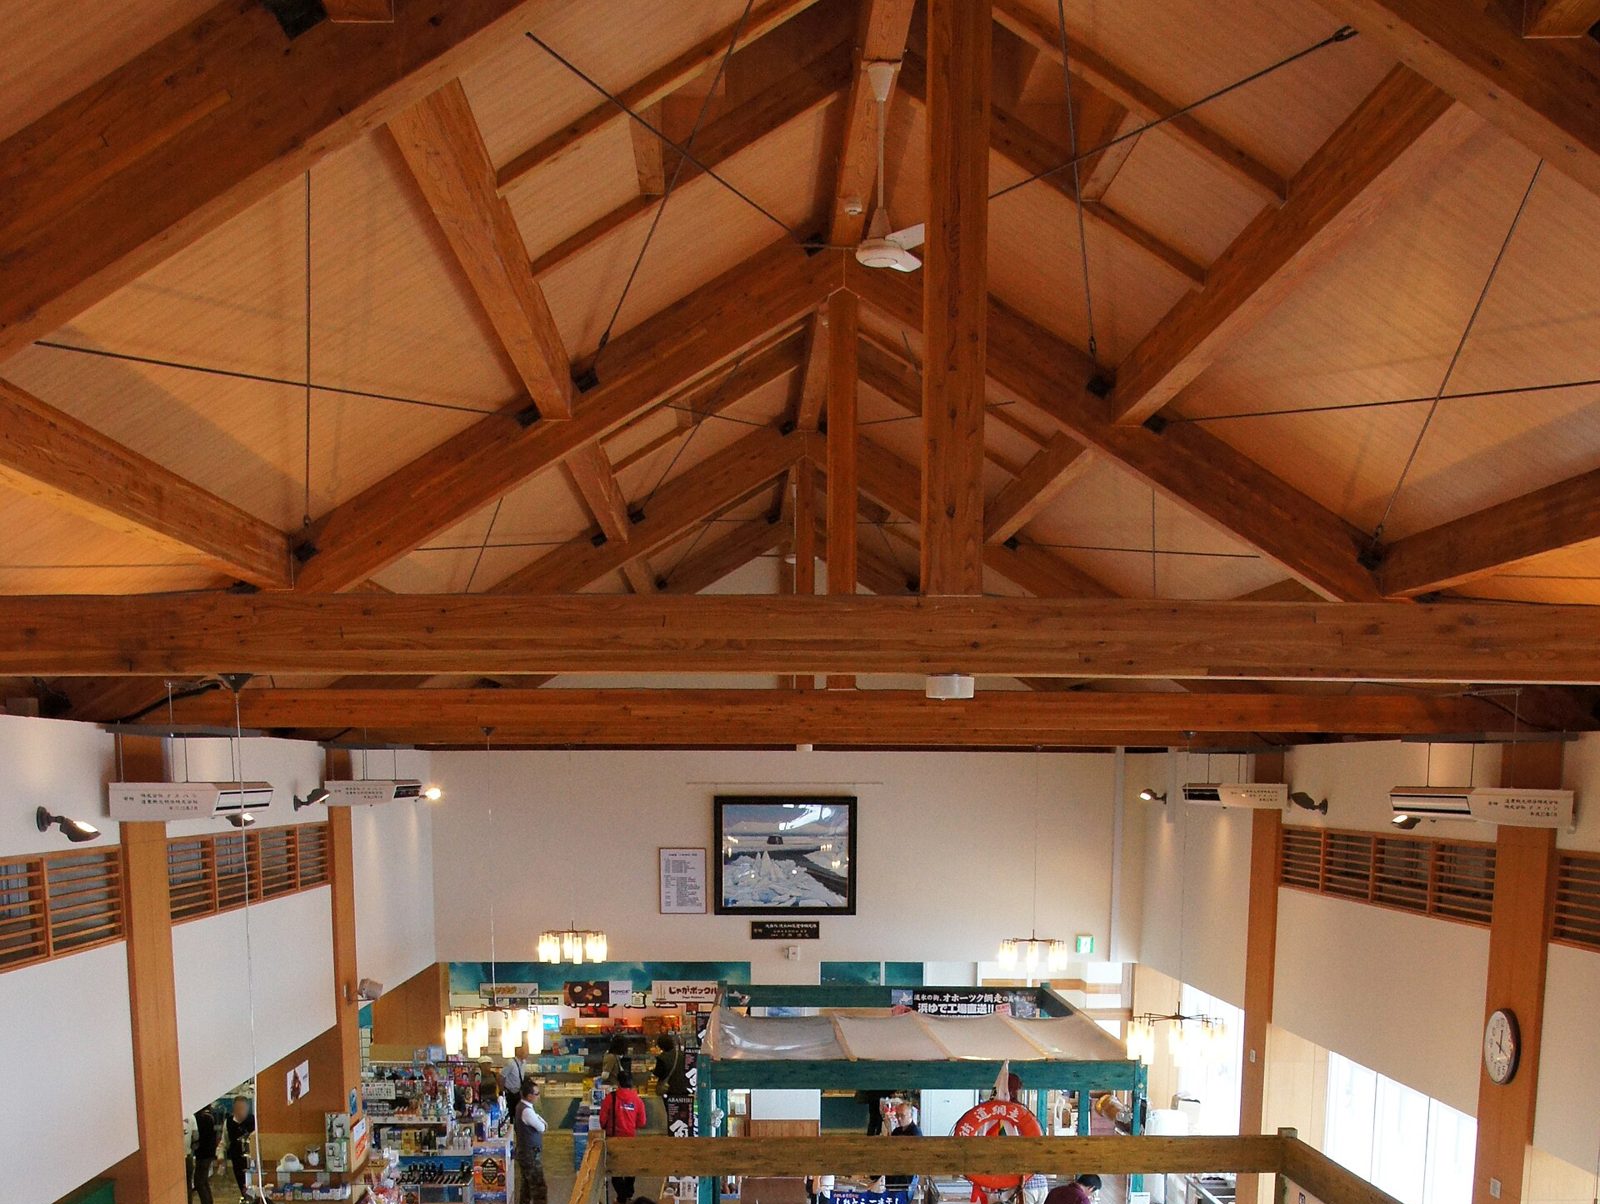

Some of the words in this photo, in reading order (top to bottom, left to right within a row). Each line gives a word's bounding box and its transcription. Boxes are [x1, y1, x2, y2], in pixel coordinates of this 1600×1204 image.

[669, 986, 717, 995] じゃがポックル
